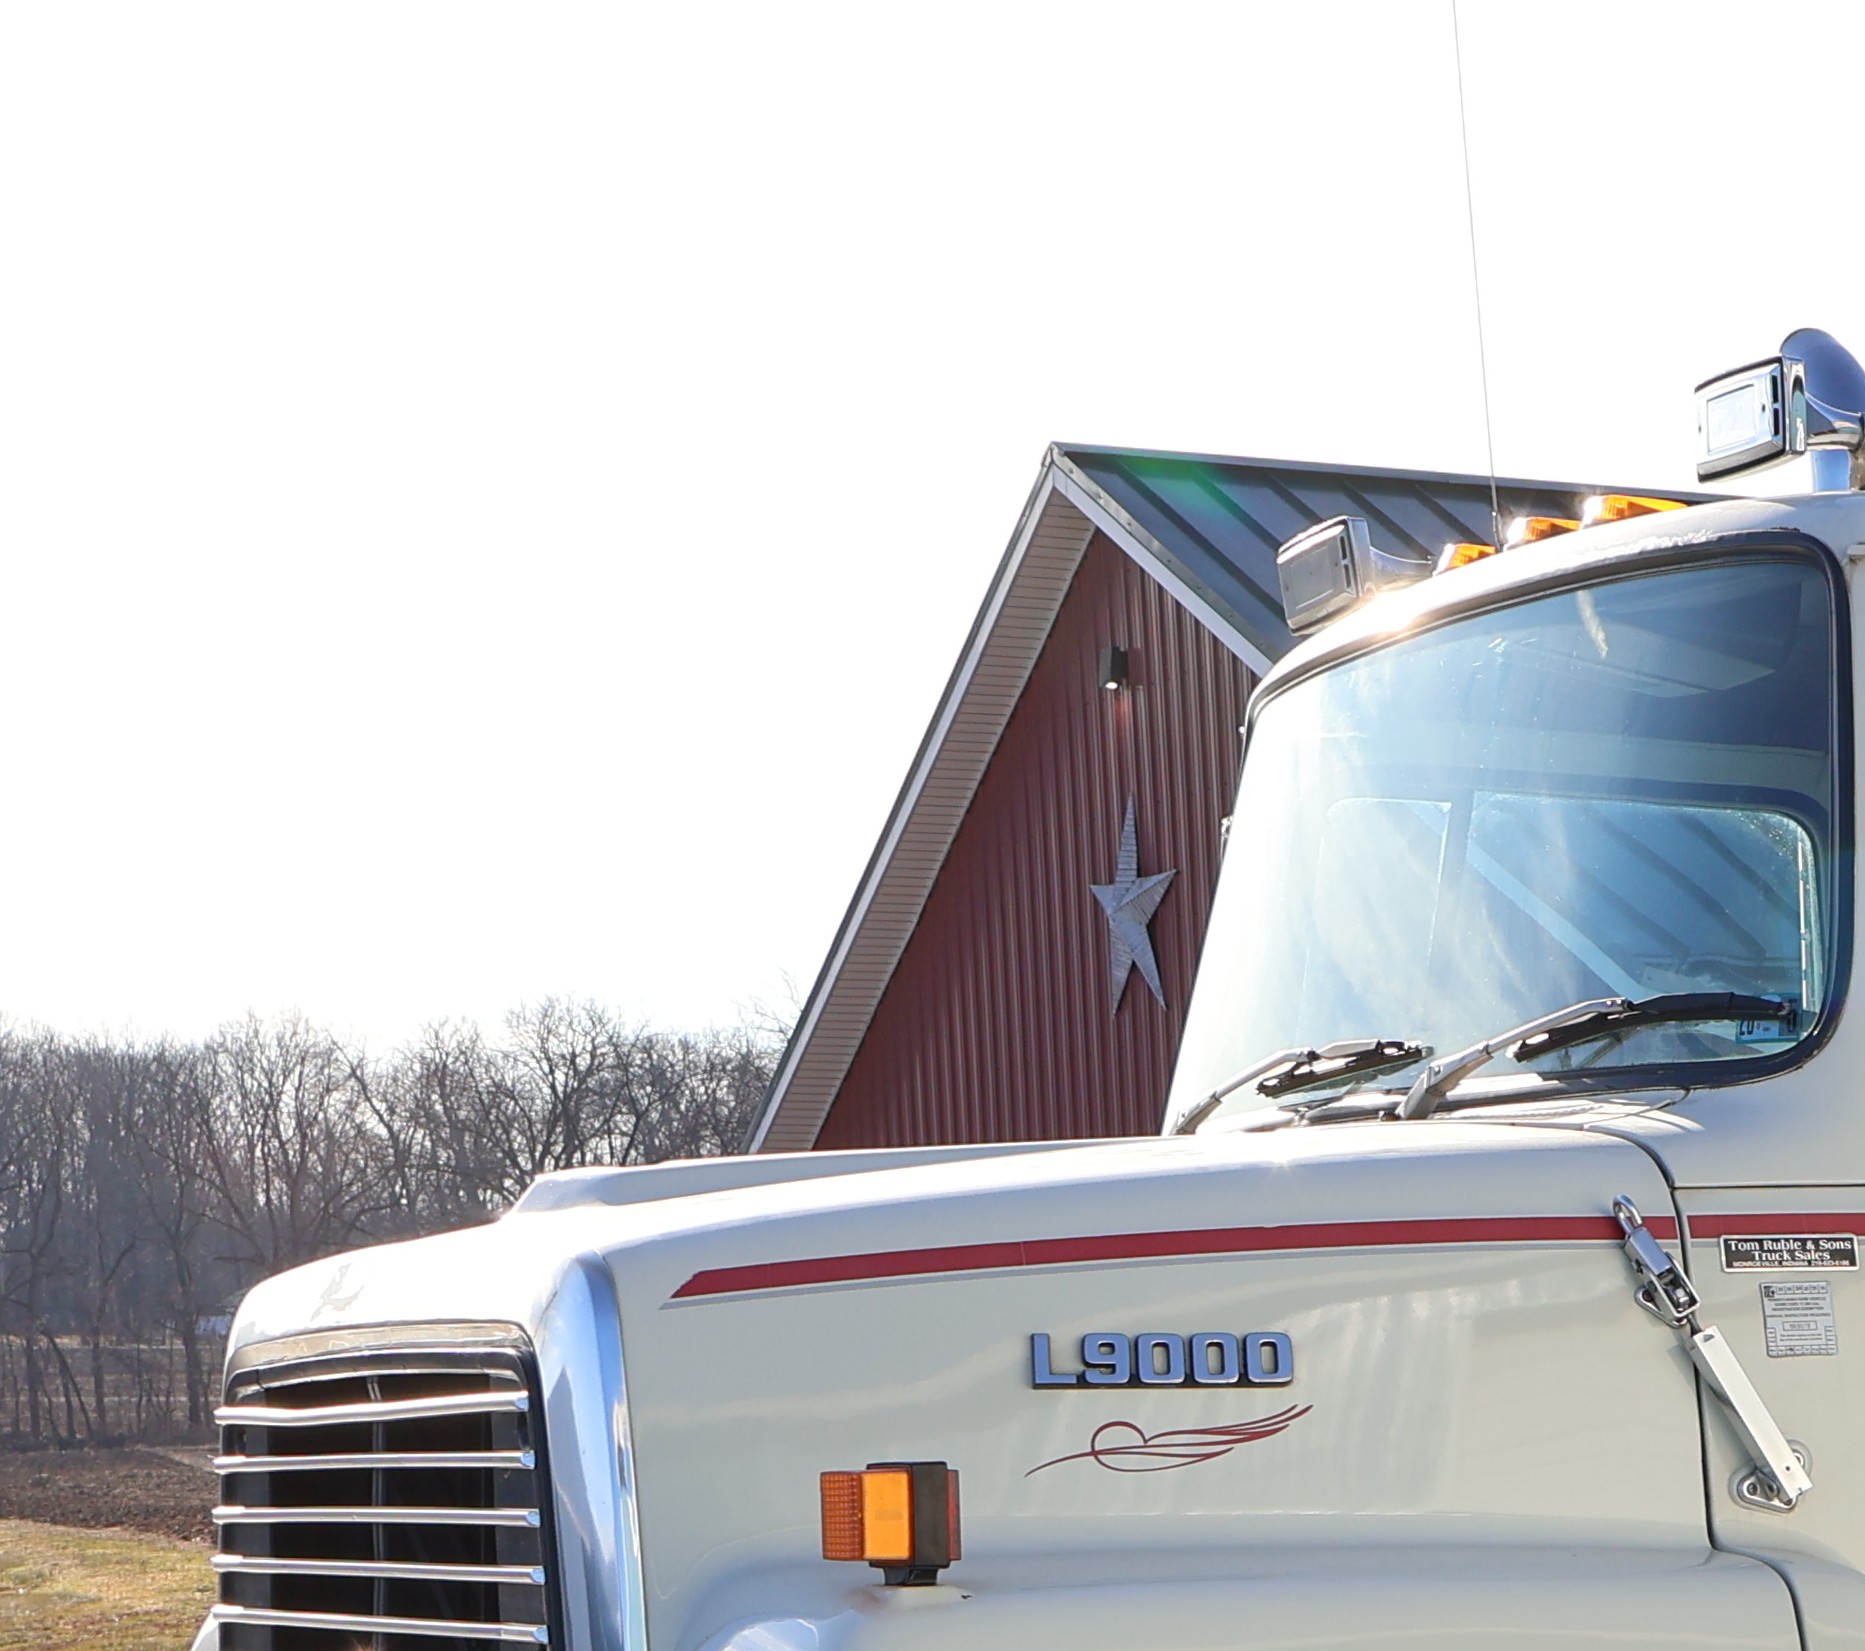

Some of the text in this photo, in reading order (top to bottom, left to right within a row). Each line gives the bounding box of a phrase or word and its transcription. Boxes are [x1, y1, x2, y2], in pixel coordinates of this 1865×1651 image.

[1728, 1239, 1852, 1251] Tom Ruble & Sons
[1751, 1250, 1830, 1261] Truck Sales
[1031, 1332, 1294, 1389] L9000
